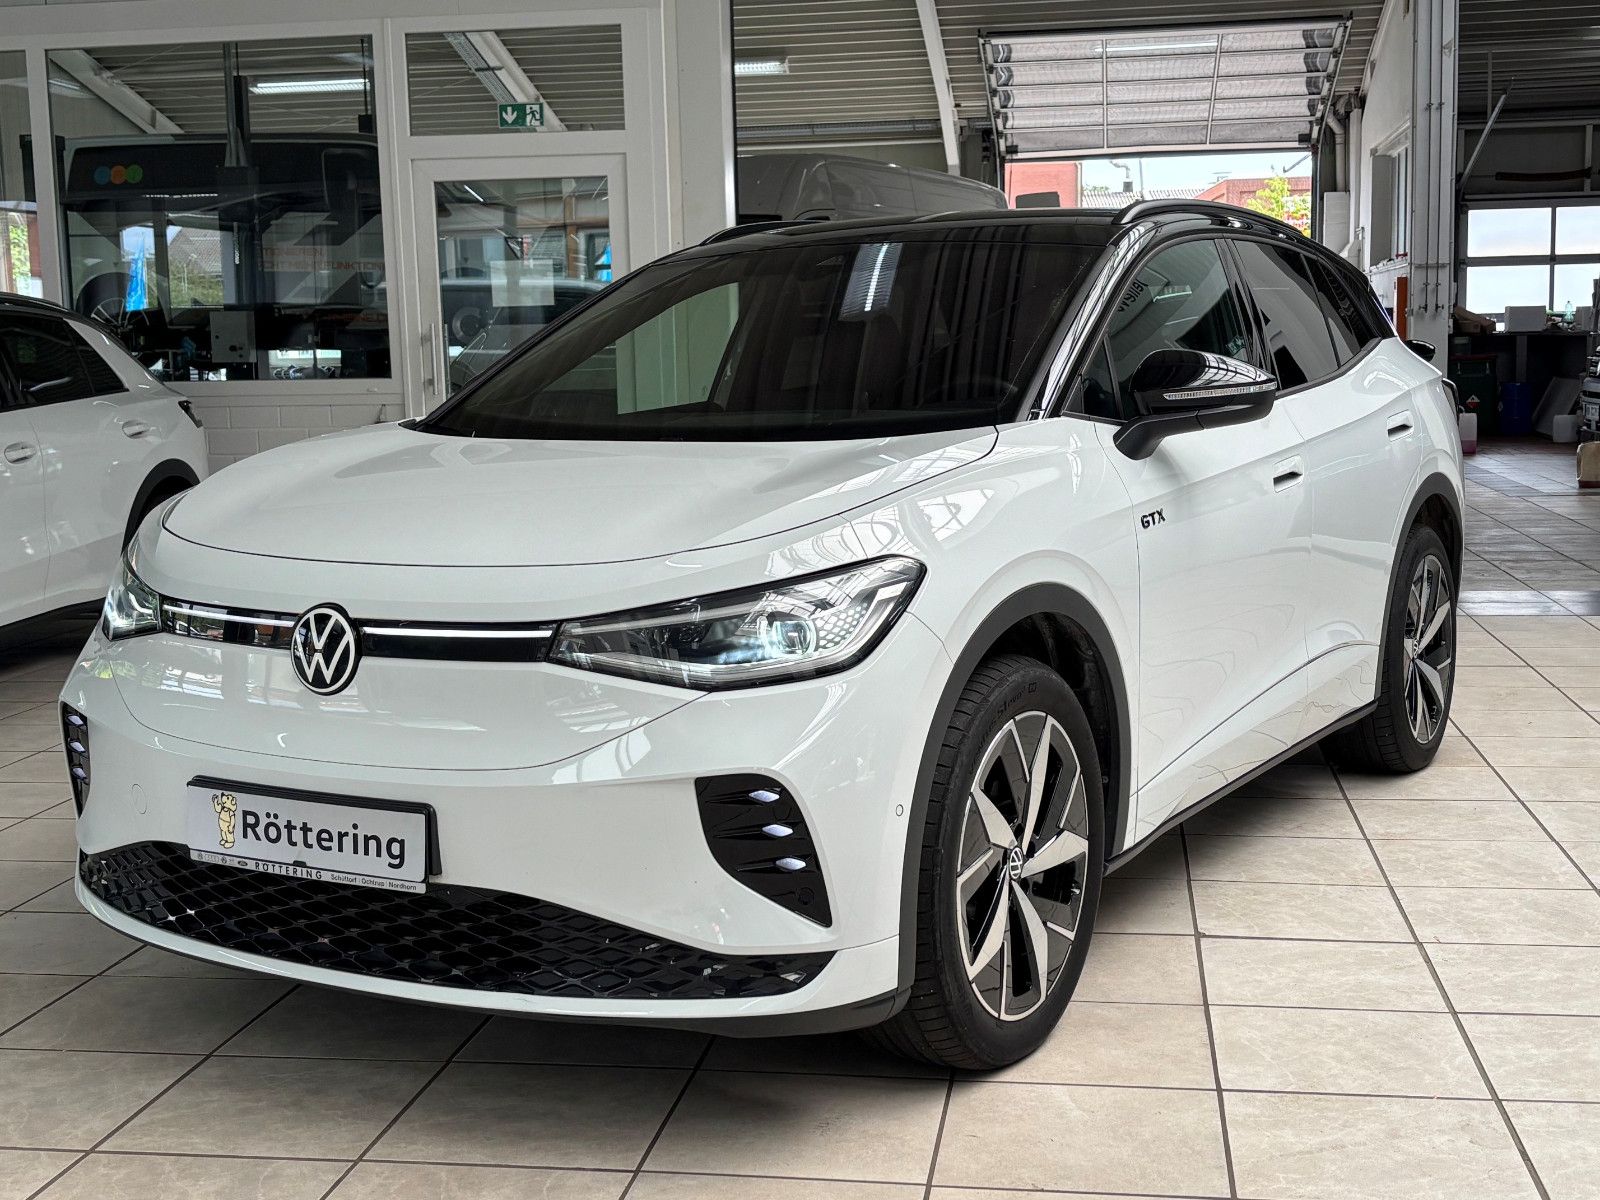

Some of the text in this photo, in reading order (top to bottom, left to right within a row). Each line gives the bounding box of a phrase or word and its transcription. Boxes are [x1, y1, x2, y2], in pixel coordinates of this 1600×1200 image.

[1140, 508, 1166, 529] GTX
[241, 809, 406, 870] Röttering
[254, 861, 323, 880] RÖTTERING
